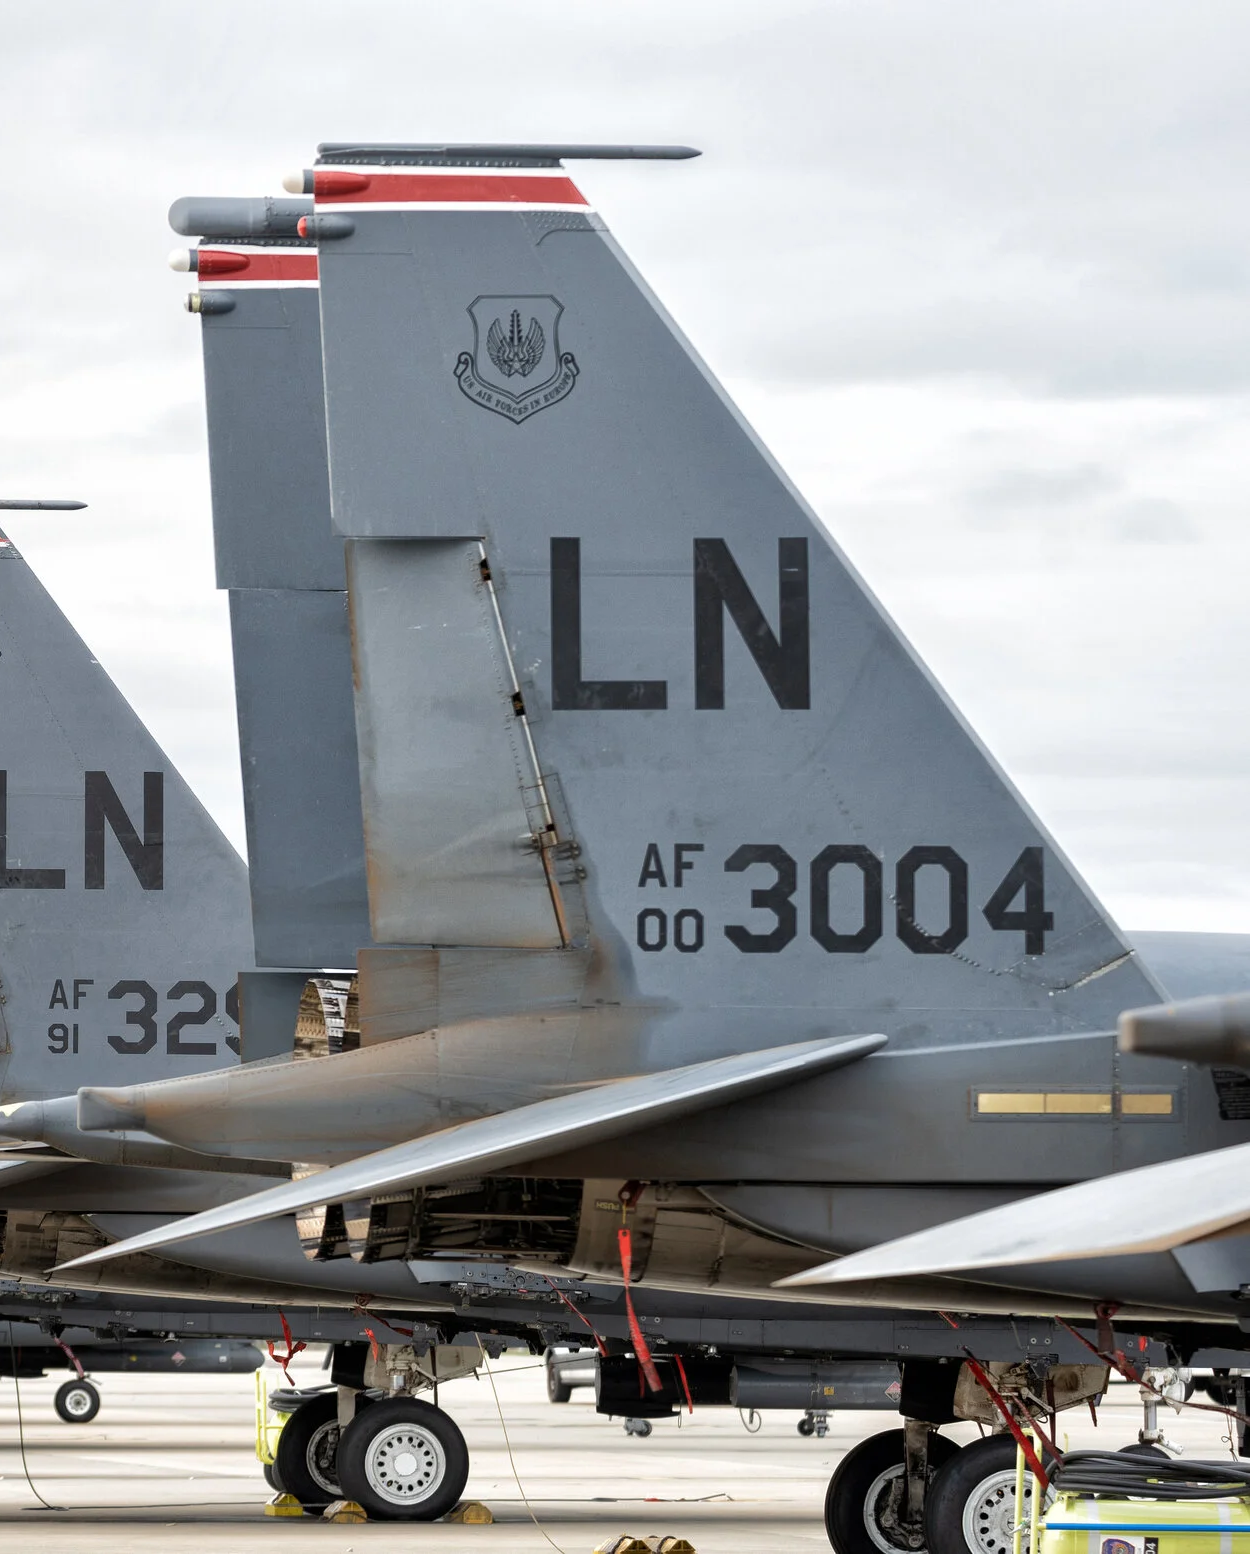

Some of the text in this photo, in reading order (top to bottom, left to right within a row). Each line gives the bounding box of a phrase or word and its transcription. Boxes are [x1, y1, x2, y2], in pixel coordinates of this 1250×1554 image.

[476, 389, 493, 404] AIR
[494, 399, 530, 417] FORCES
[543, 371, 572, 403] EUROPE
[550, 537, 810, 710] LN
[638, 843, 704, 888] AF
[724, 844, 1054, 956] 3004
[637, 908, 704, 953] 00
[48, 979, 95, 1010] AF
[48, 1024, 79, 1055] 91
